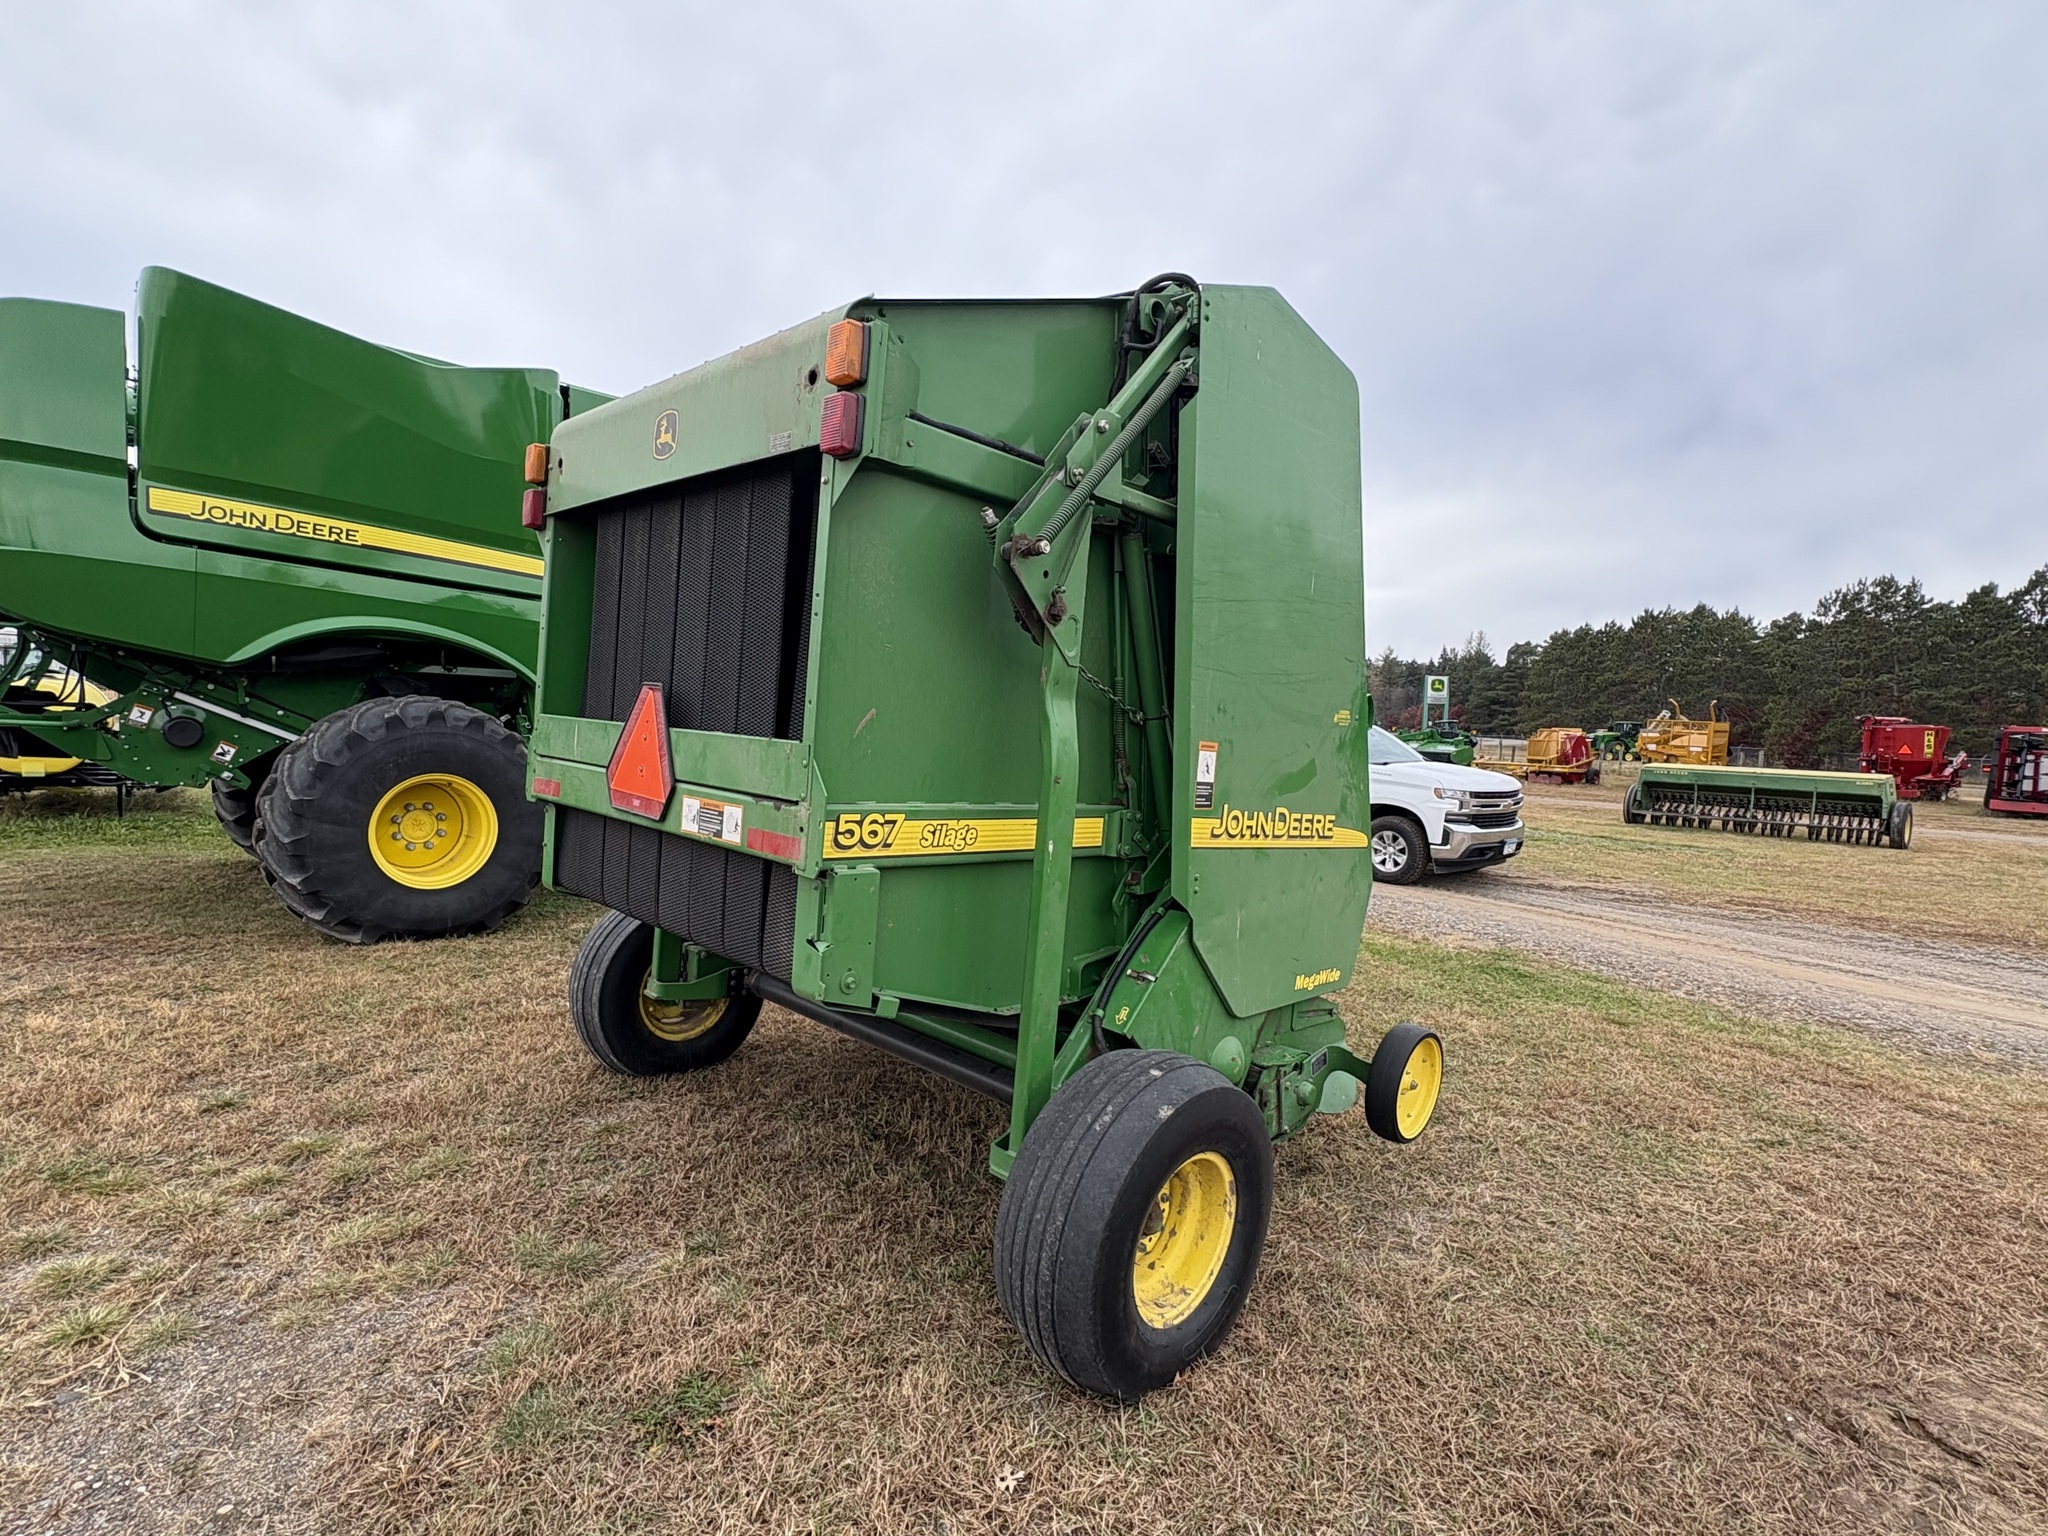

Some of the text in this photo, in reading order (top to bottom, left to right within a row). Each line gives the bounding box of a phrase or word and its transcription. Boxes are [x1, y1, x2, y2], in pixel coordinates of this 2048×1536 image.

[190, 500, 361, 543] JOHN DEERE
[834, 813, 979, 851] 567 Silage
[1210, 803, 1336, 839] JOHN DEERE
[1294, 967, 1342, 991] MegaWide
